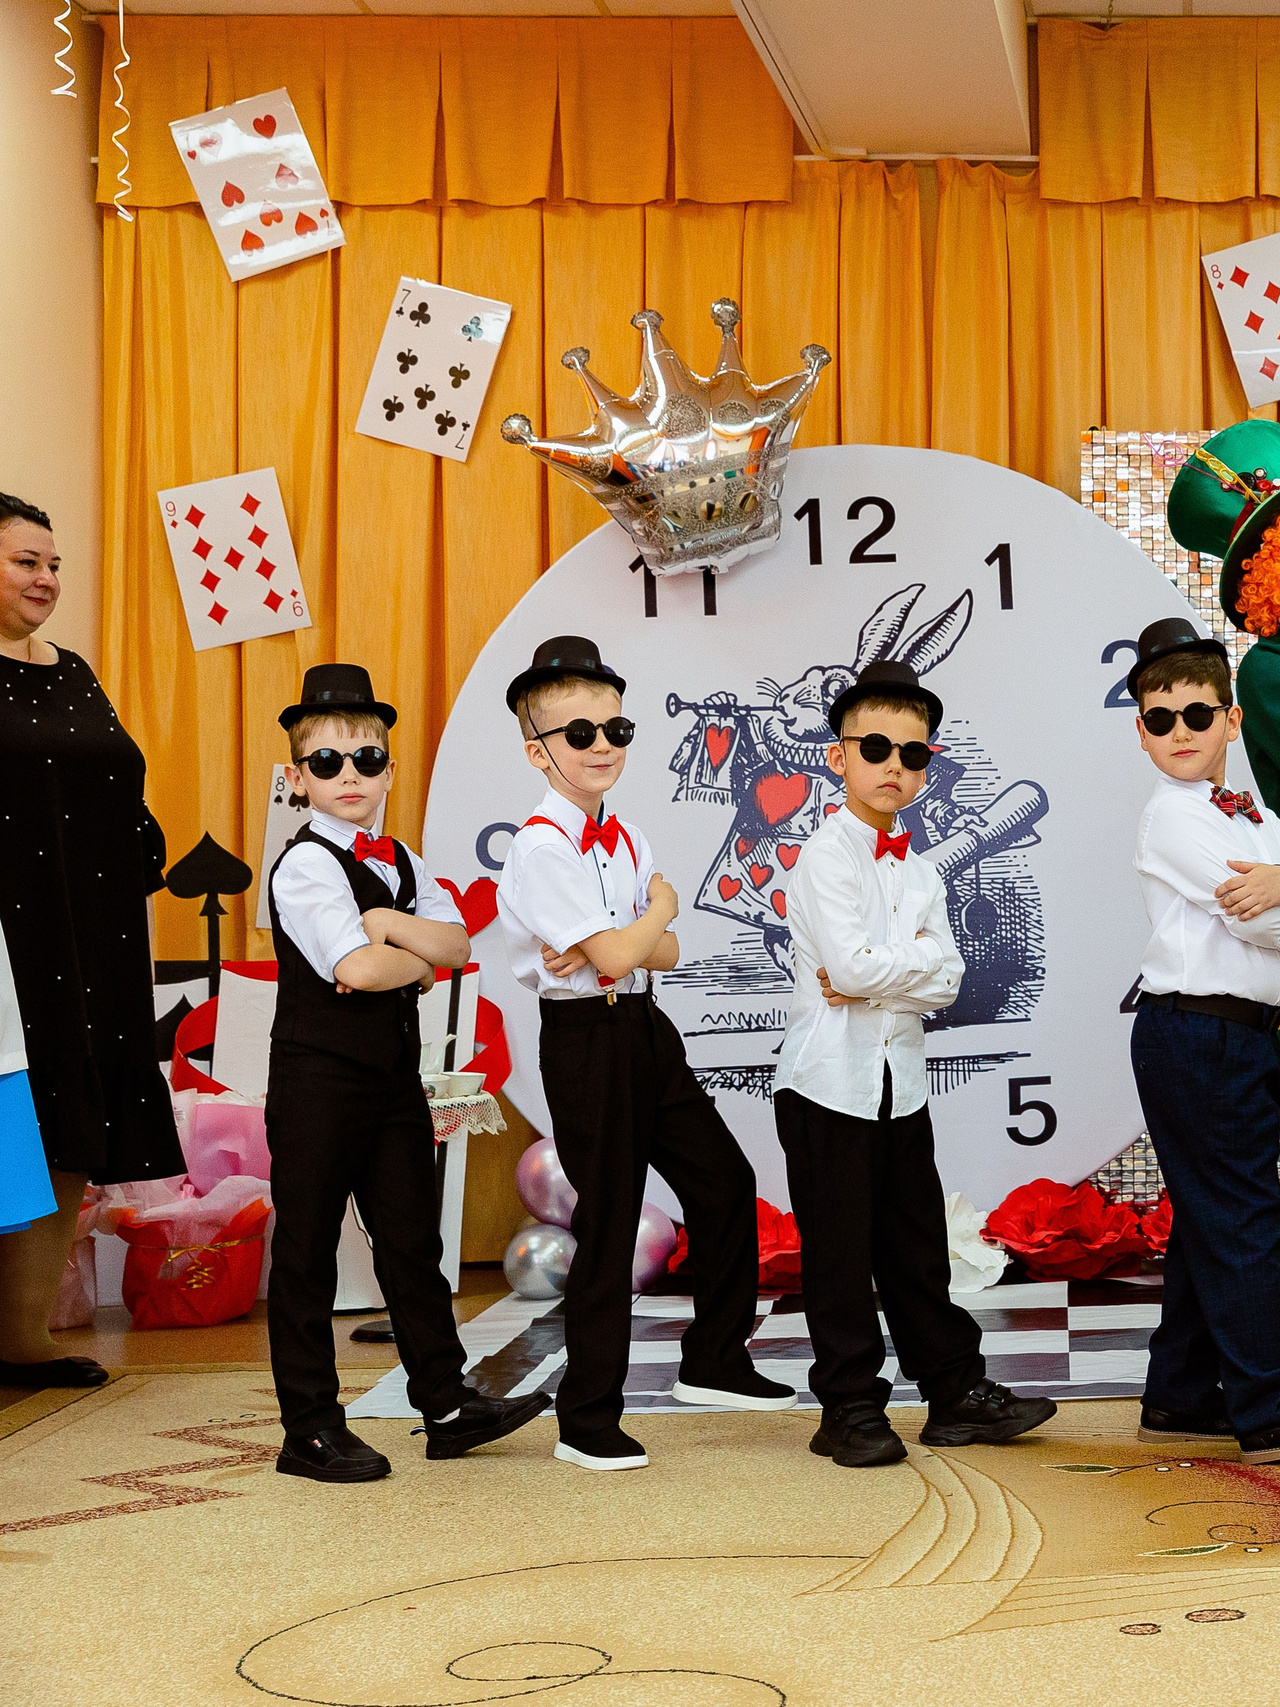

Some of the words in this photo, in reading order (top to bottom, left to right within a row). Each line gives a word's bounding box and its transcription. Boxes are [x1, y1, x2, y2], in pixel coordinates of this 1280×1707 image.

[1210, 264, 1222, 280] 8
[401, 288, 412, 305] 7
[454, 433, 465, 450] 7
[165, 500, 176, 517] 9
[793, 496, 897, 565] 12
[984, 543, 1014, 610] 1
[1101, 639, 1140, 708] 2
[275, 776, 286, 792] 8
[1006, 1076, 1057, 1146] 5
